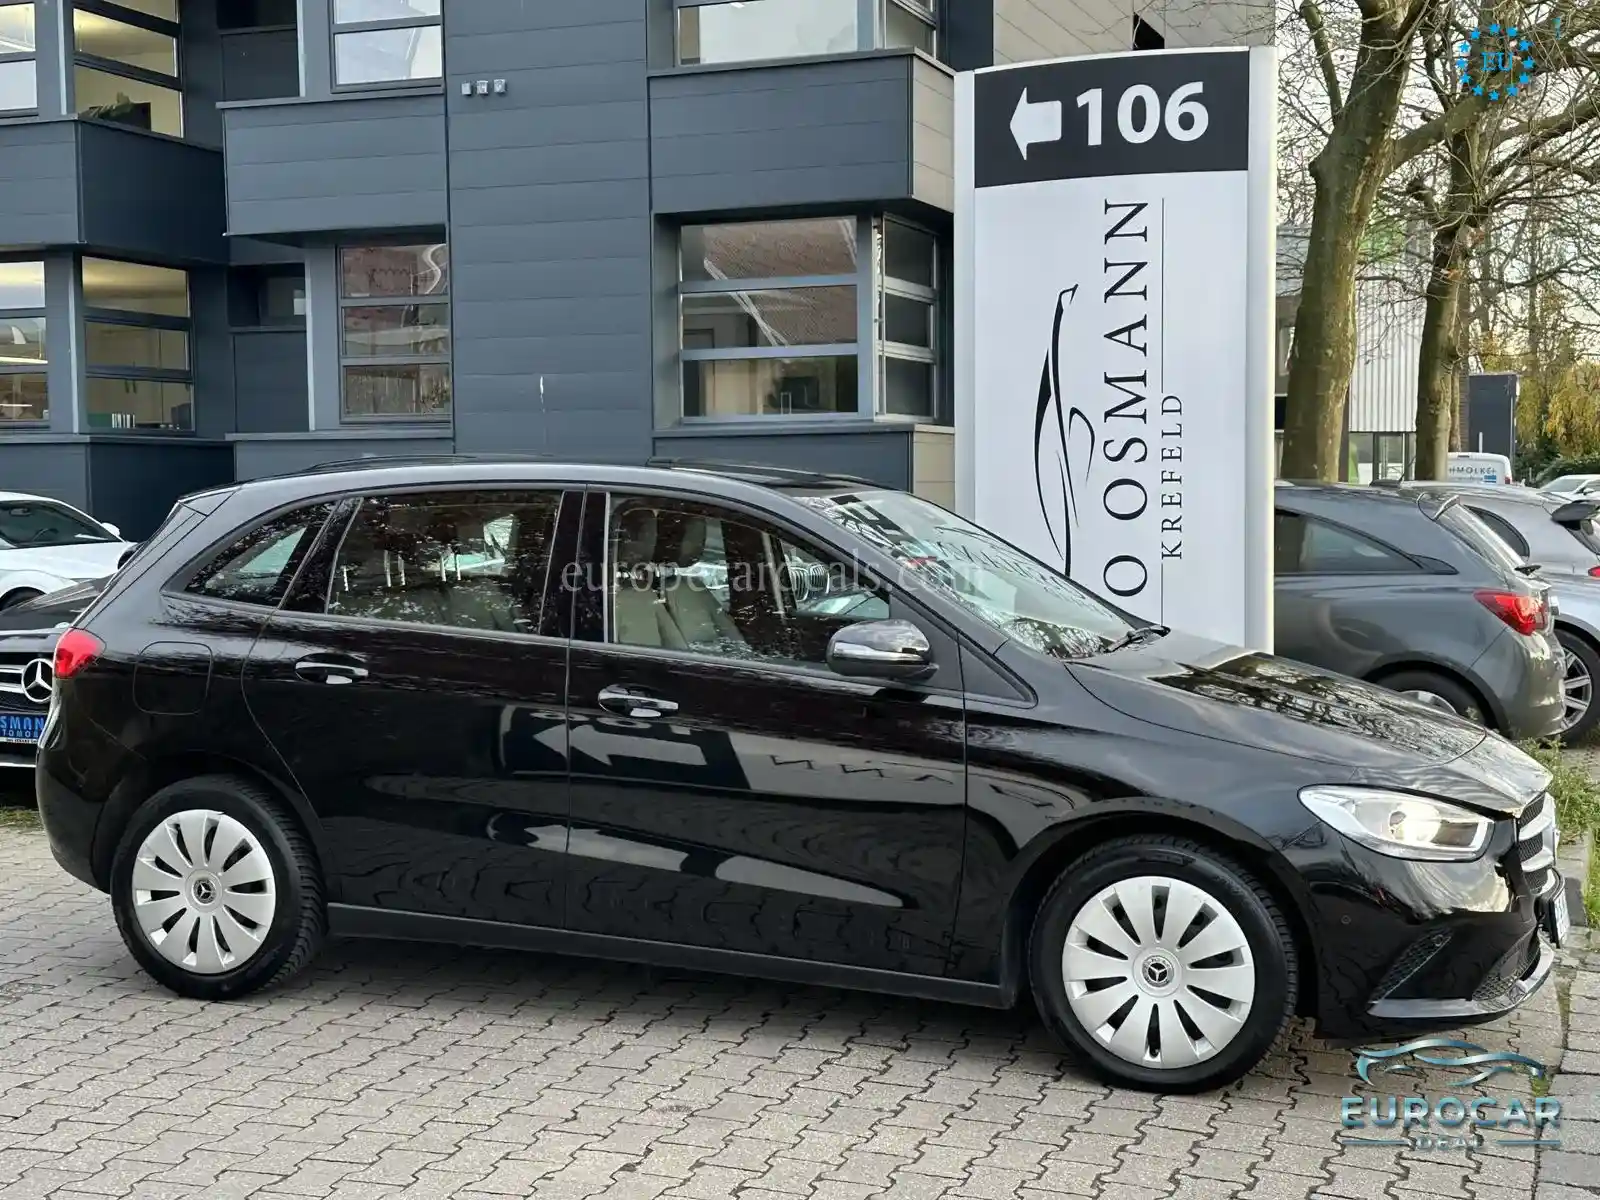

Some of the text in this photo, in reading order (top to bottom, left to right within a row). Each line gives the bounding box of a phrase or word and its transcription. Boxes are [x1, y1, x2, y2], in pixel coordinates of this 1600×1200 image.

[1077, 82, 1209, 146] 106
[1103, 198, 1149, 521] OSMANN
[1161, 395, 1183, 560] KREFELD
